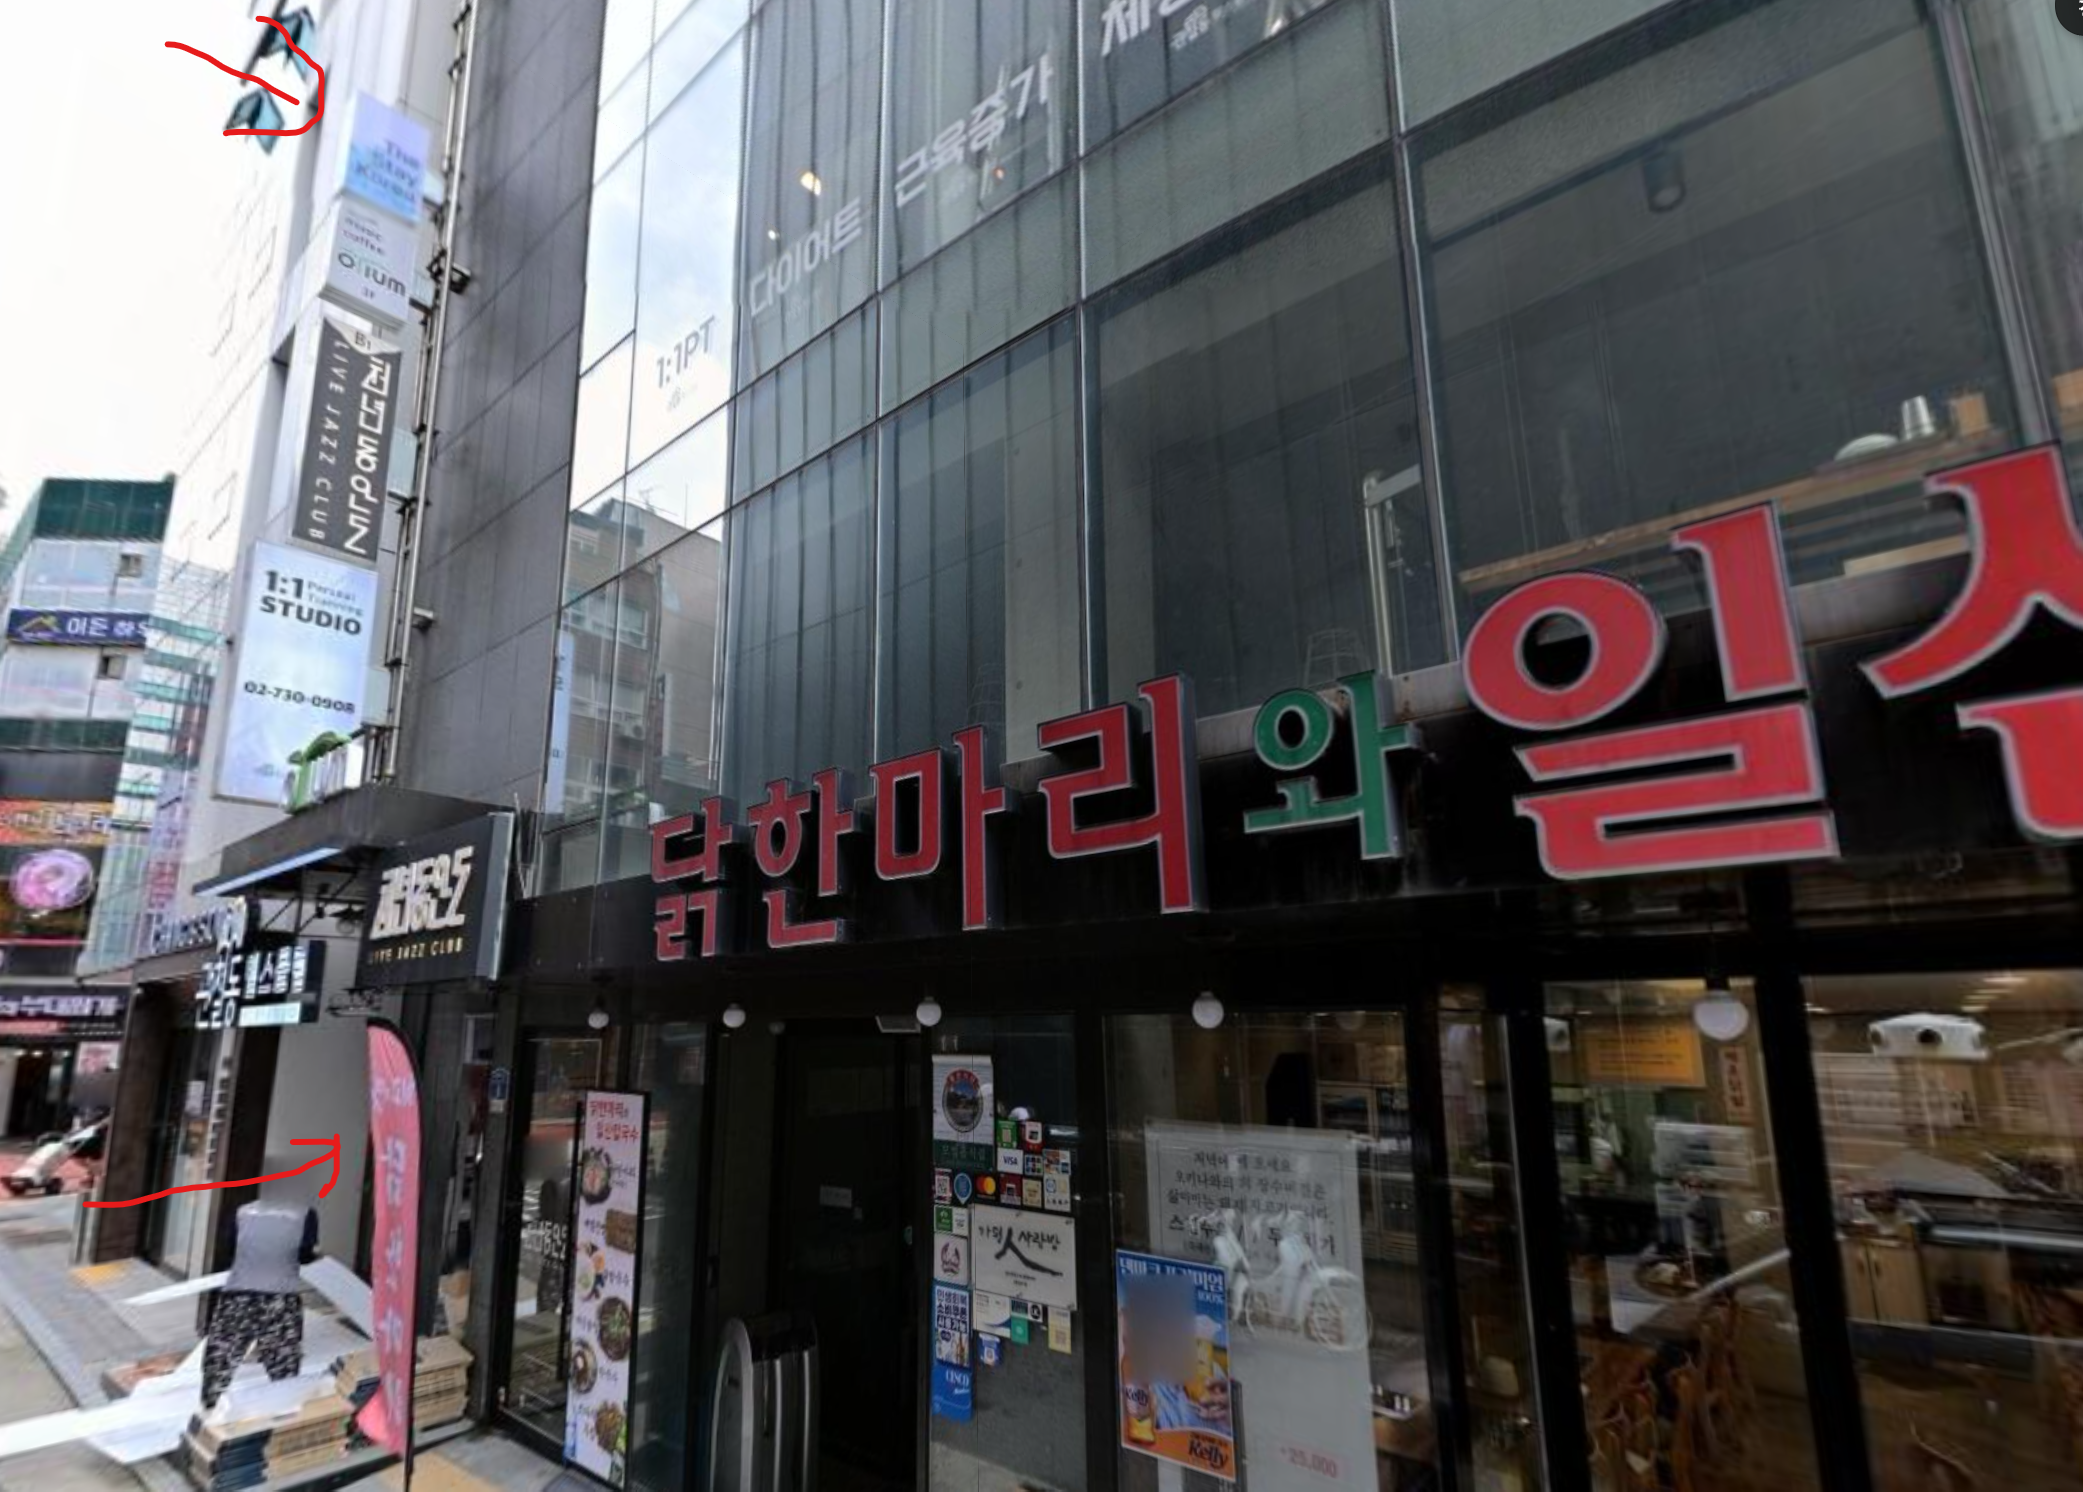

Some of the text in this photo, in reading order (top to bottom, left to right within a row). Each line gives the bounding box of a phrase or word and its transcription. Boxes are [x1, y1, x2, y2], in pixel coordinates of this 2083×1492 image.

[895, 52, 1054, 208] 근육증가
[750, 197, 862, 318] 다이어트
[356, 331, 372, 350] B1
[308, 340, 350, 540] LIVE JAZZ CLUB
[265, 569, 305, 600] 1:1
[260, 595, 362, 636] STUDIO
[1003, 1155, 1018, 1166] VISA
[1188, 1439, 1229, 1470] Kelly
